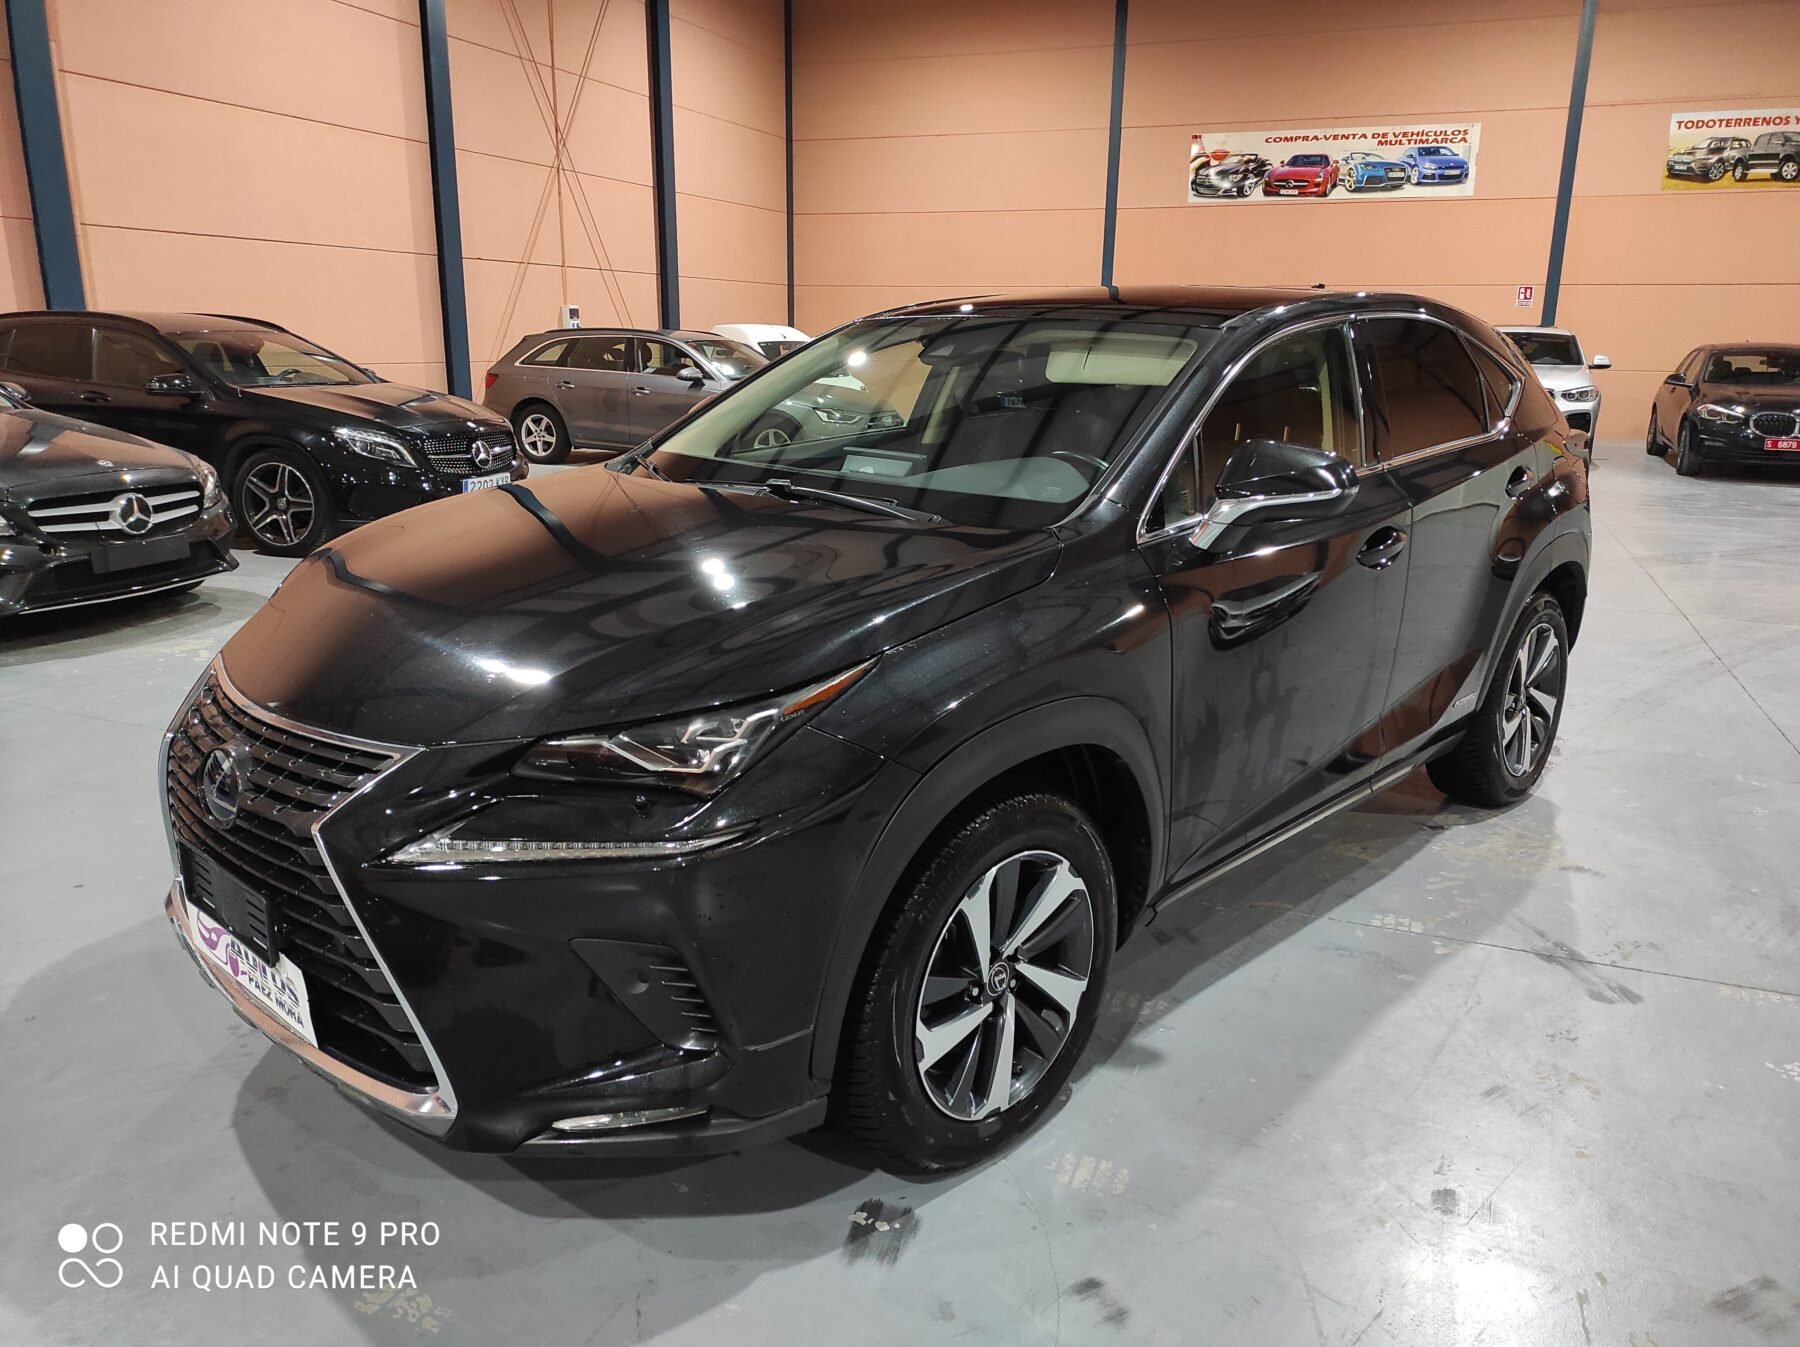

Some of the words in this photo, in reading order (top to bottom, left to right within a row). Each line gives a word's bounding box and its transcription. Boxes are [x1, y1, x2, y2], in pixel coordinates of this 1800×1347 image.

[1676, 116, 1791, 130] TODOTERRENOS
[1264, 133, 1368, 143] COMPRA-VENTA
[1393, 129, 1469, 139] VEHÍCULOS
[1377, 137, 1468, 146] MULTIMARCA
[1767, 440, 1773, 448] S
[275, 991, 305, 1029] MORA
